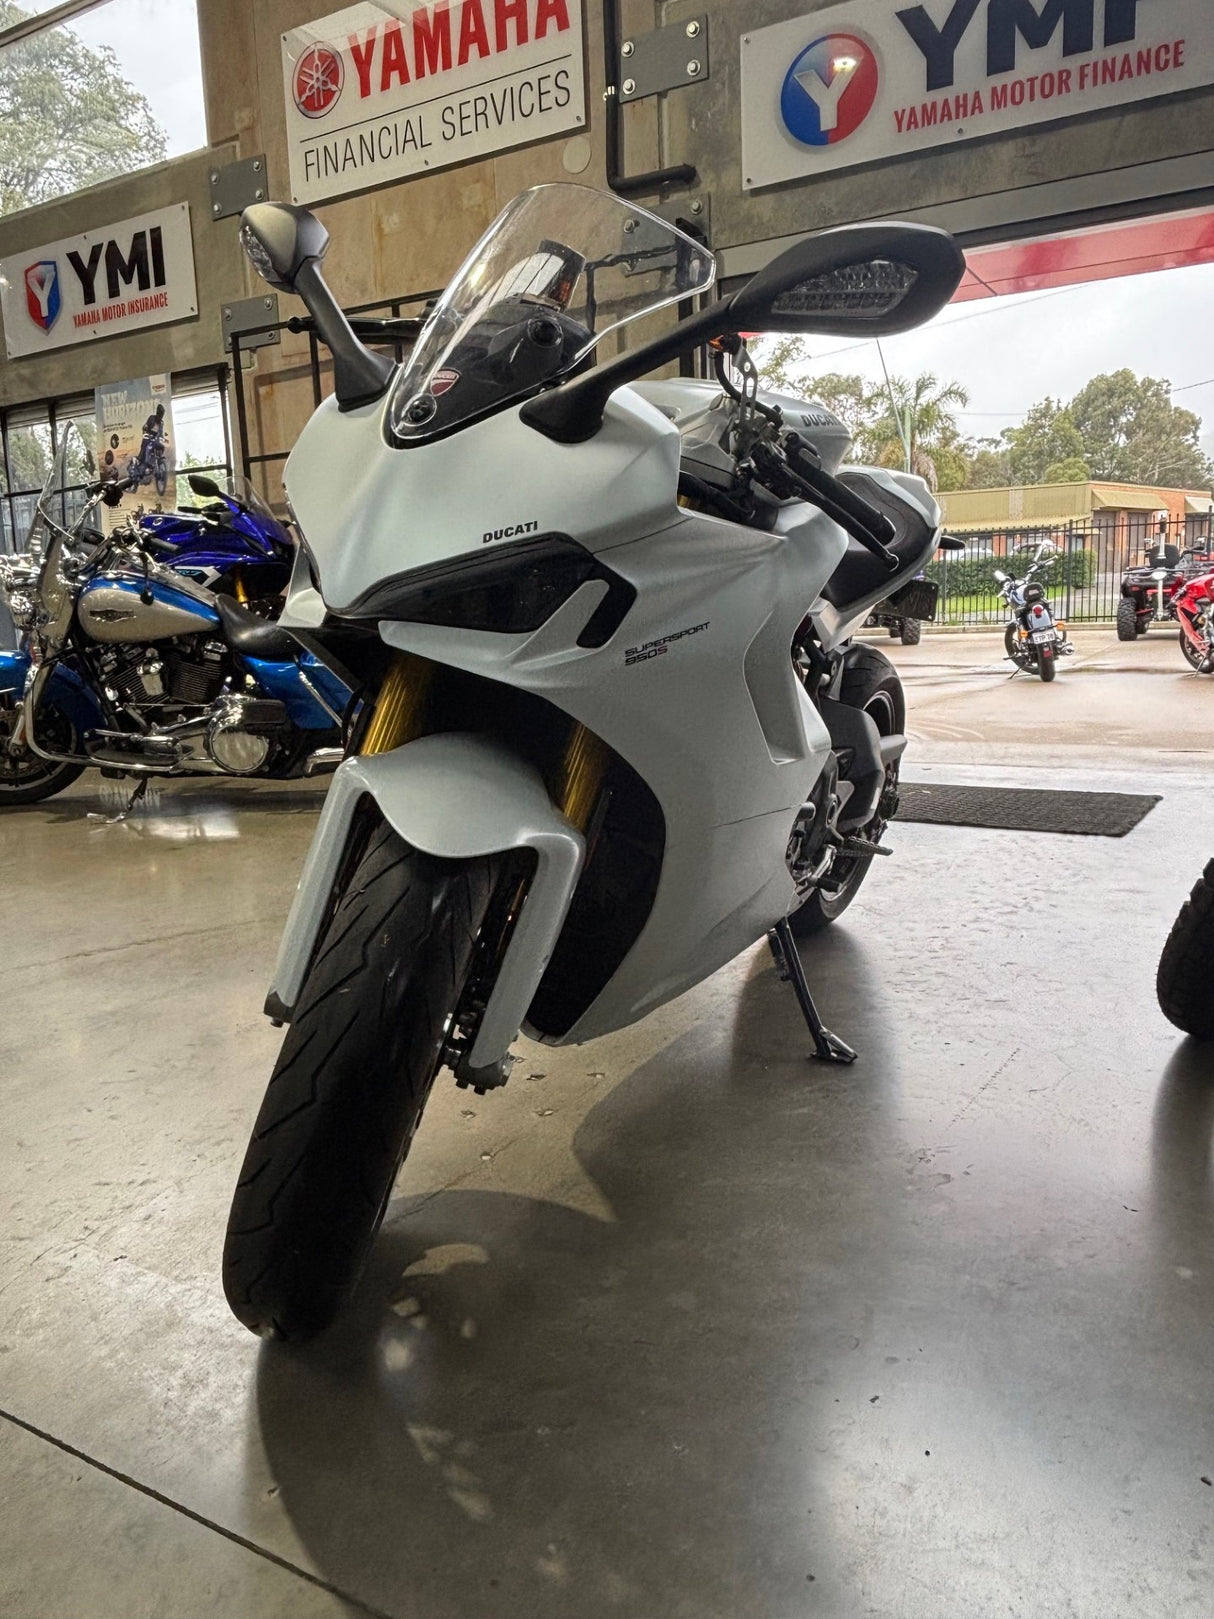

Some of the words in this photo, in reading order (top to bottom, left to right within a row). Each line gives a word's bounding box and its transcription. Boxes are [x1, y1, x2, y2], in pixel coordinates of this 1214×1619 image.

[894, 90, 984, 133] YAMAHA
[991, 68, 1072, 111] MOTOR
[1079, 39, 1185, 91] FINANCE
[304, 115, 432, 182] FINANCIAL
[441, 70, 571, 141] SERVICES
[66, 226, 166, 305] YMI
[73, 309, 101, 328] YAMAHA
[102, 303, 127, 321] MOTOR
[128, 292, 168, 315] INSURANCE
[101, 390, 128, 408] NEW
[483, 521, 538, 544] DUCATI
[625, 621, 710, 658] SUPERSPORT
[625, 645, 668, 666] 950S
